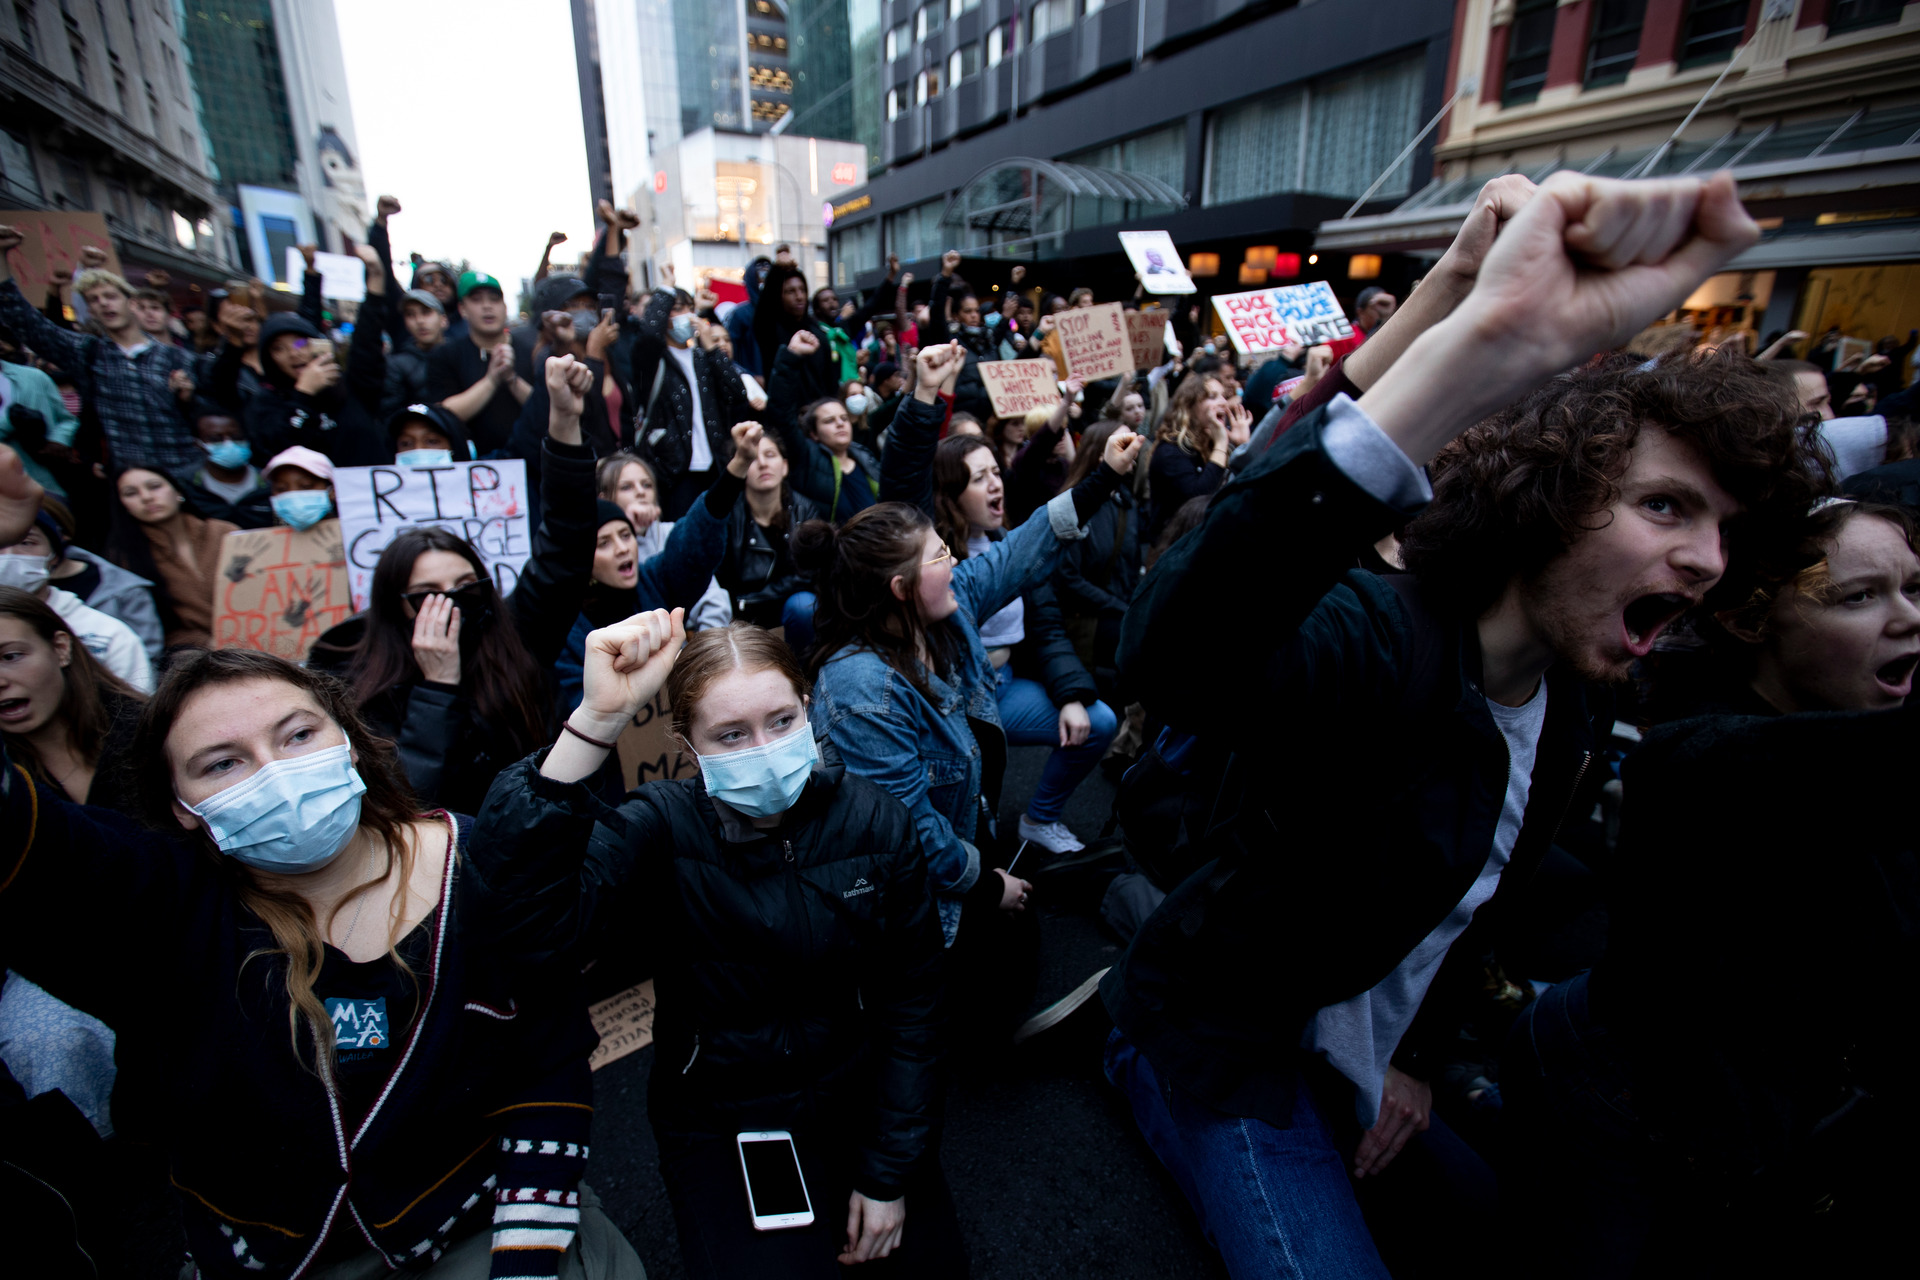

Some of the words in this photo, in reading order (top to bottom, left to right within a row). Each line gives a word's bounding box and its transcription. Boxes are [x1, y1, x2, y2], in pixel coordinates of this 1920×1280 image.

[1225, 295, 1273, 315] FUCK
[1060, 313, 1089, 336] STOP
[1231, 312, 1281, 332] FUCK
[1065, 329, 1104, 348] KILLING
[1240, 328, 1292, 352] FUCK
[1295, 317, 1355, 346] HATE
[1068, 341, 1102, 359] BLACK
[986, 362, 1048, 379] DESTROY
[1073, 359, 1115, 377] PEOPLE
[1002, 378, 1036, 394] WHITE
[370, 464, 500, 524] RIP
[265, 527, 303, 571] I
[350, 515, 529, 570] GRGE
[338, 1051, 374, 1064] WAILEA
